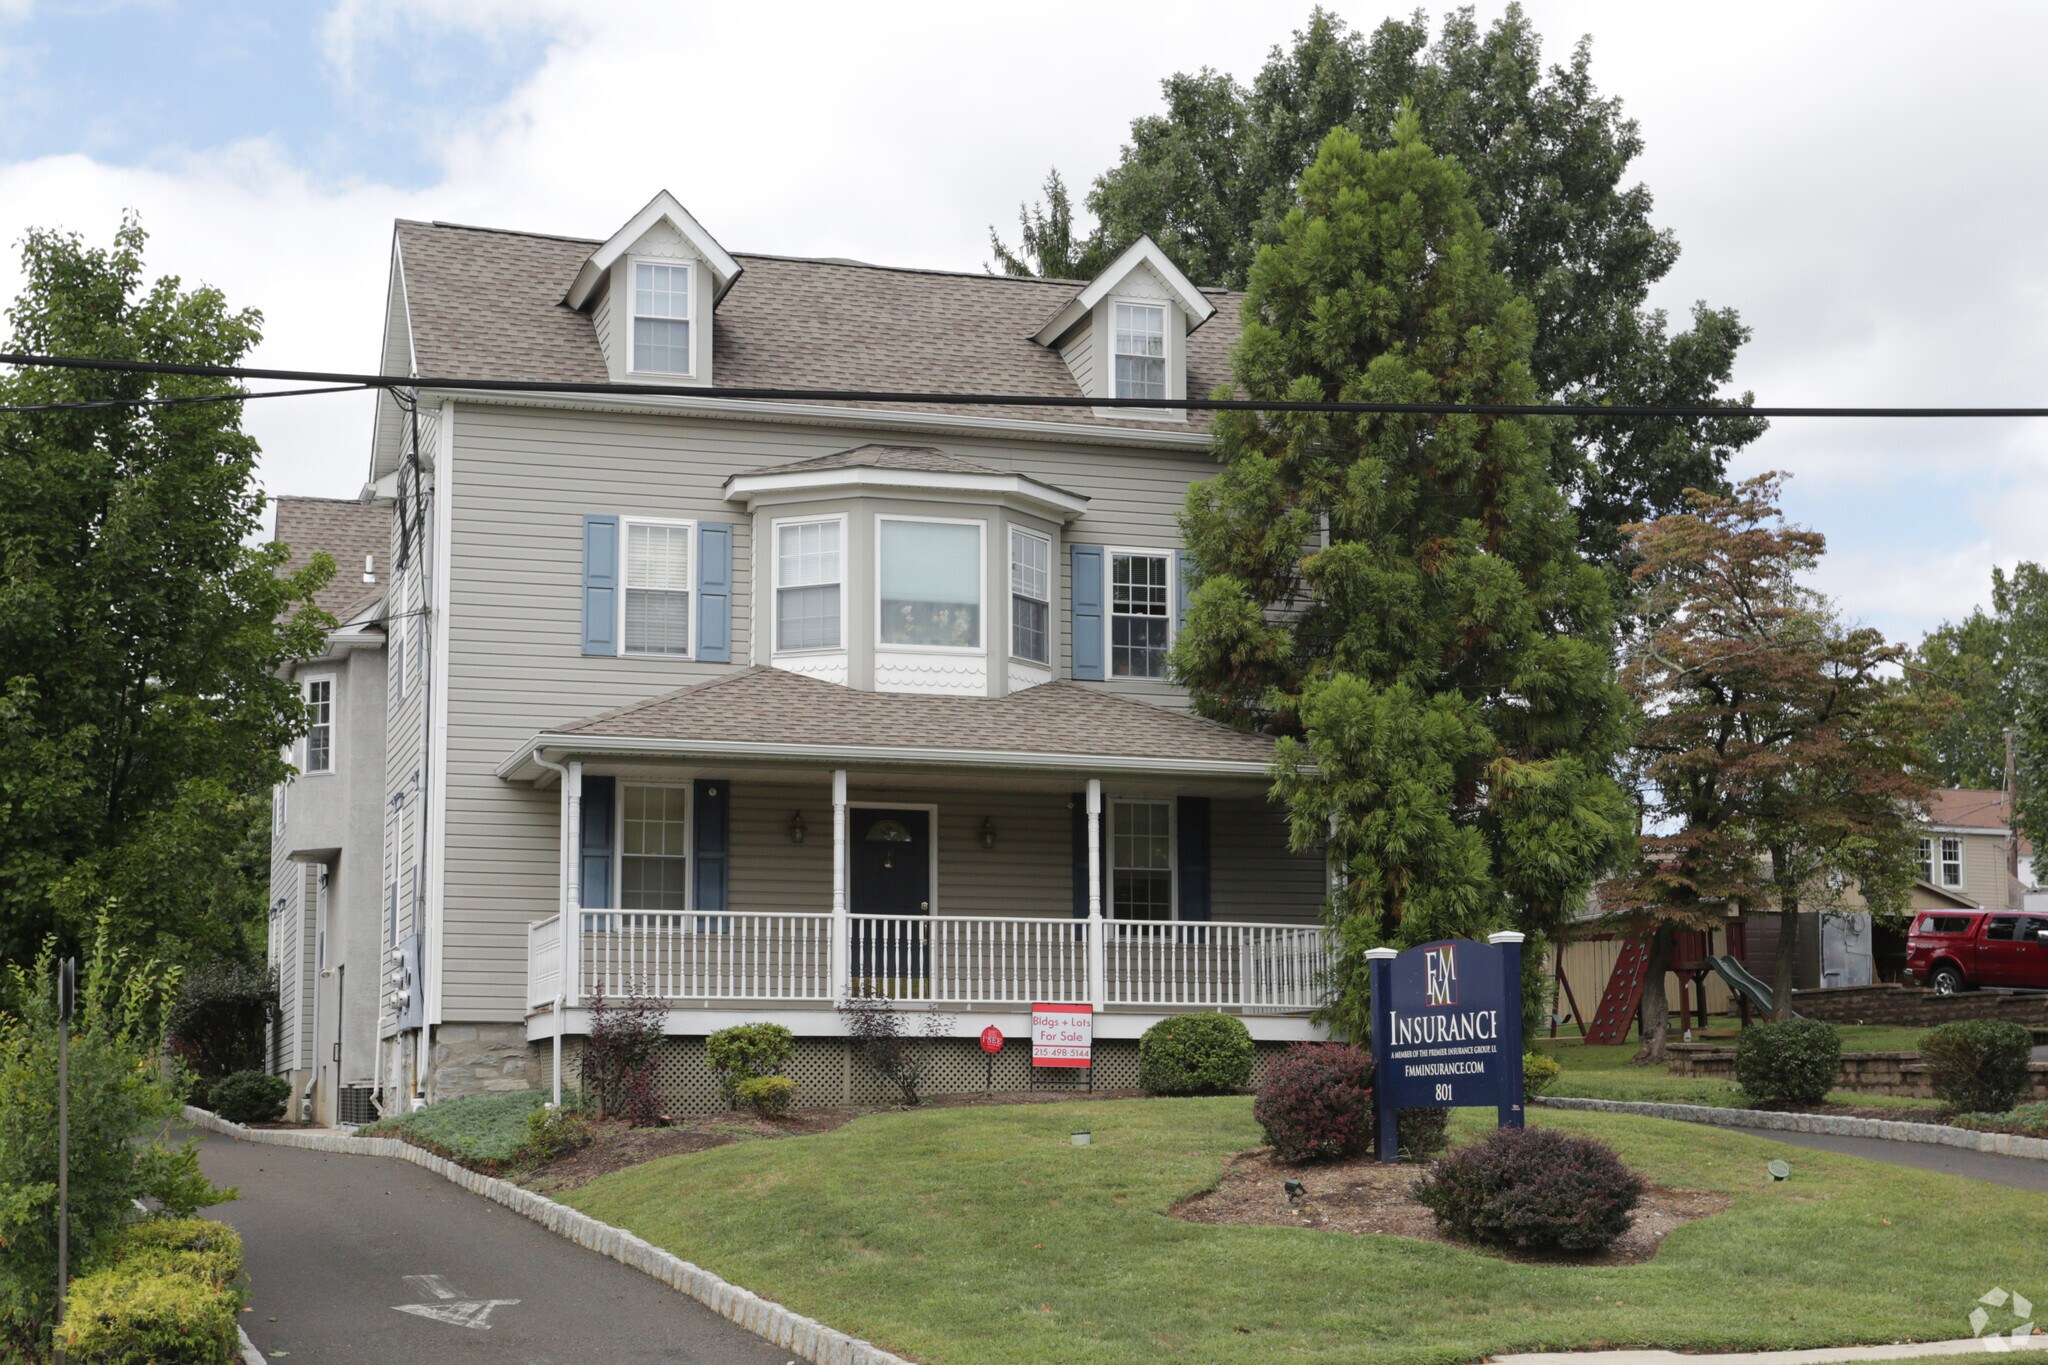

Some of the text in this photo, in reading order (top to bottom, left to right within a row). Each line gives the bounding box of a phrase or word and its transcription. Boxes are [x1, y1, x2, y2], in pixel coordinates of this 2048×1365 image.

[1033, 1016, 1059, 1029] Bldgs
[1071, 1017, 1091, 1027] Lots
[1040, 1030, 1083, 1042] For Sale
[1390, 1051, 1395, 1059] A
[1395, 1050, 1412, 1059] MEMBER
[1412, 1049, 1419, 1058] OF
[1419, 1049, 1428, 1058] THE
[1428, 1048, 1448, 1057] PREMIER
[1448, 1046, 1473, 1056] INSURANCE
[1405, 1061, 1484, 1077] FMMINSURANCE.COM
[1435, 1083, 1453, 1101] 801
